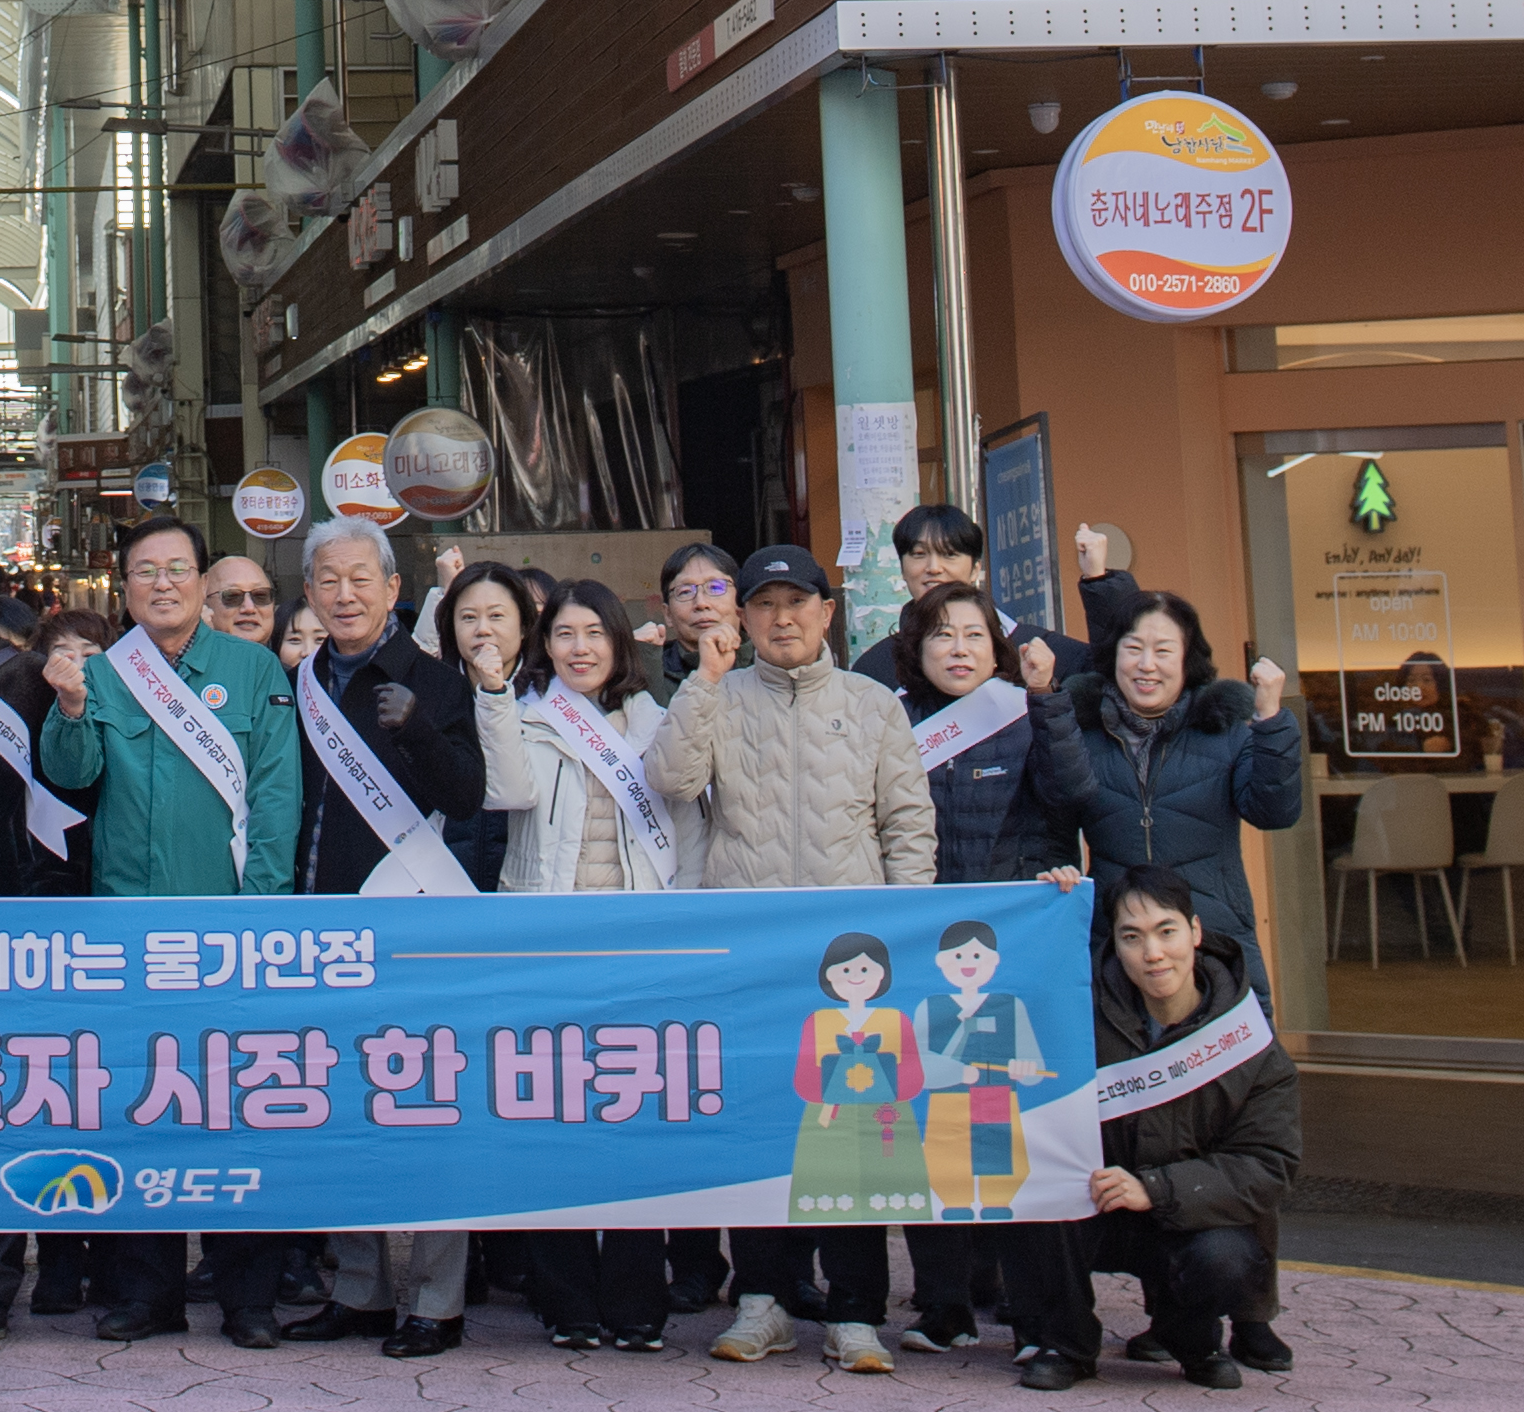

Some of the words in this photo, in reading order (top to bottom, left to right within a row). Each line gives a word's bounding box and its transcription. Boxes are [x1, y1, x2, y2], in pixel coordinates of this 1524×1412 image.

[1091, 189, 1233, 229] 춘자네노래주점
[1240, 188, 1274, 233] 2F
[1129, 273, 1240, 294] 010-2571-2860
[334, 472, 388, 492] 미소화
[394, 450, 489, 478] 미니고래집
[1369, 595, 1414, 614] open
[1351, 623, 1380, 642] AM
[1388, 622, 1438, 642] 10:00
[1374, 682, 1423, 702] close
[127, 648, 187, 720] 전통시장을
[183, 715, 243, 794] 이용합시다
[1357, 712, 1386, 732] PM
[1393, 712, 1444, 732] 10:00
[326, 731, 394, 812] 이용합시다
[549, 693, 621, 767] 전통시장을
[615, 764, 671, 851] 이용합시다
[143, 928, 377, 991] 물가안정
[1169, 1021, 1253, 1081] 전통시장을
[126, 1025, 340, 1131] 시장
[356, 1024, 468, 1128] 한
[488, 1020, 725, 1124] 바퀴!
[134, 1166, 262, 1208] 영도구
